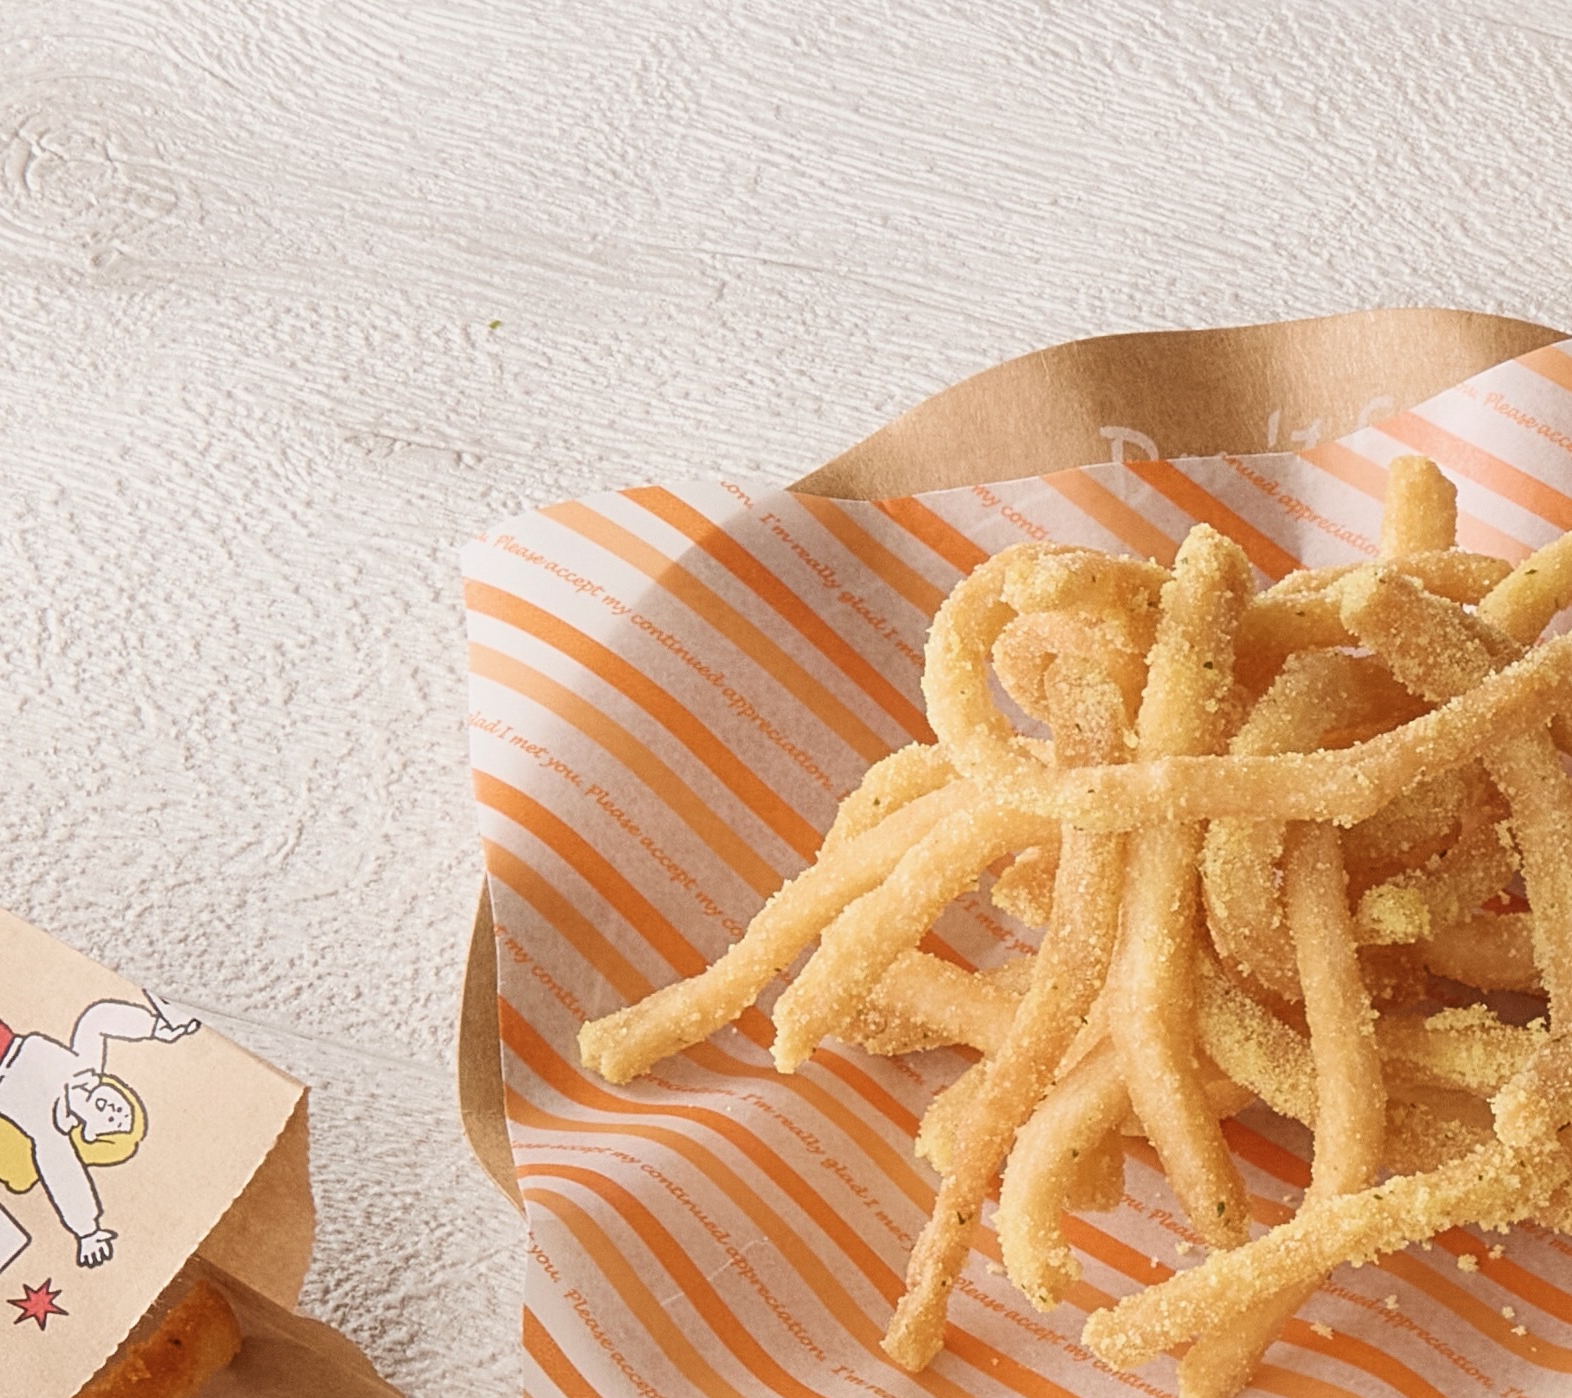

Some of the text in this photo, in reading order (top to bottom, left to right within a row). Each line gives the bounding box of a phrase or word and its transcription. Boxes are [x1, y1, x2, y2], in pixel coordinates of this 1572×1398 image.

[1484, 391, 1538, 429] Please
[1277, 492, 1383, 557] appreciatio
[543, 556, 605, 598] accept
[601, 593, 632, 617] my
[629, 611, 727, 688] continued
[584, 781, 642, 839] Please
[639, 1159, 730, 1242] continued
[724, 1244, 829, 1364] appreciation.
[564, 1288, 615, 1355] Please
[1003, 1309, 1068, 1346] accept
